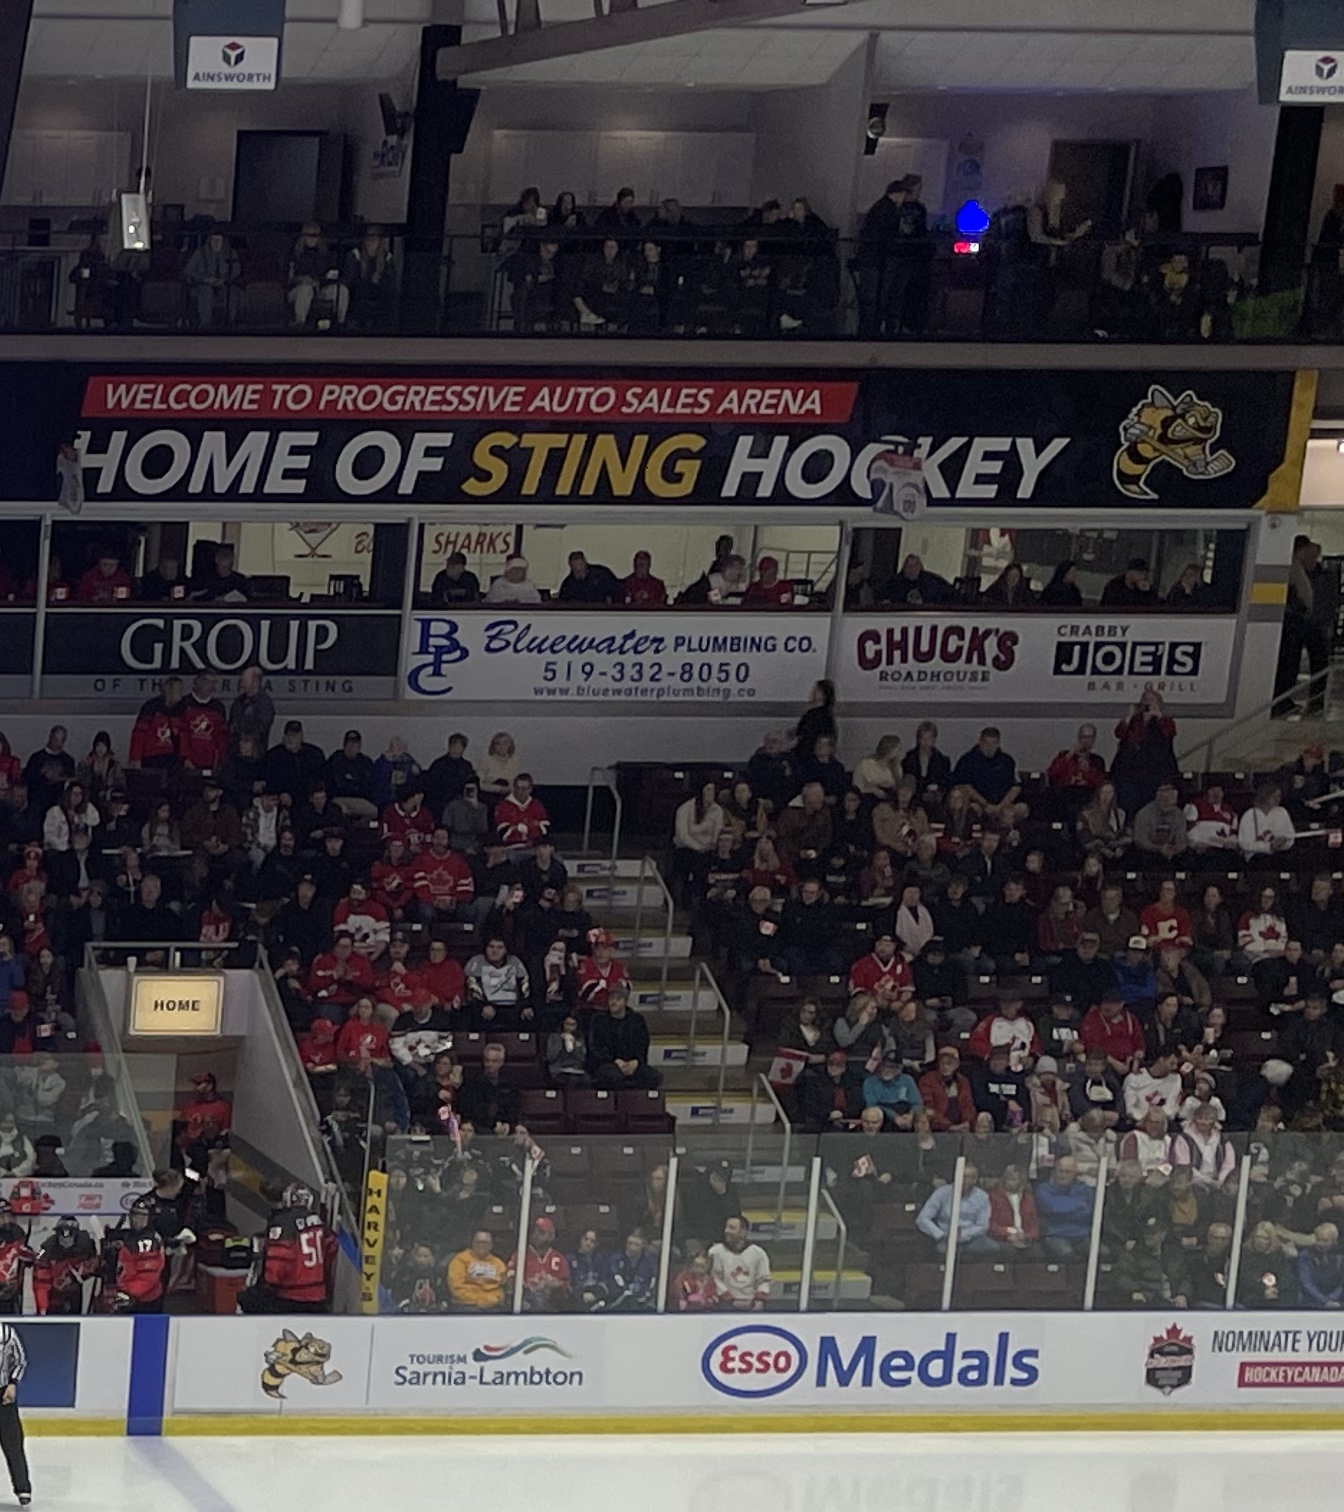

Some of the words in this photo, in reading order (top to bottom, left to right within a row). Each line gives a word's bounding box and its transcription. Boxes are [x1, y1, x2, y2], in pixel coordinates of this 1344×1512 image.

[192, 71, 272, 83] AINSWORTH
[106, 384, 265, 411] WELCOME
[268, 385, 315, 411] TO
[318, 385, 527, 413] PROGRESSIVE
[527, 387, 616, 413] AUTO
[620, 388, 714, 415] SALES
[715, 389, 823, 415] ARENA
[75, 430, 320, 495] HOME
[334, 431, 453, 495] OF
[459, 431, 707, 498] STING
[432, 531, 512, 555] SHARKS
[483, 619, 667, 656] Bluewater
[674, 635, 778, 653] PLUMBING
[1057, 624, 1130, 638] CRABBY
[120, 617, 339, 671] GROUP
[856, 625, 1020, 672] CHUCK'S
[1062, 643, 1198, 674] JOE'S
[93, 678, 122, 692] OF
[286, 679, 354, 694] STING
[878, 669, 991, 683] ROADHOUSE
[1085, 680, 1125, 692] BAR
[153, 999, 201, 1011] HOME
[138, 1239, 153, 1253] 17
[1212, 1329, 1302, 1354] NOMINATE
[408, 1354, 468, 1365] TOURISM
[717, 1344, 793, 1375] Esso
[814, 1331, 1041, 1389] Medals
[393, 1365, 584, 1387] Sarnia-Lambton
